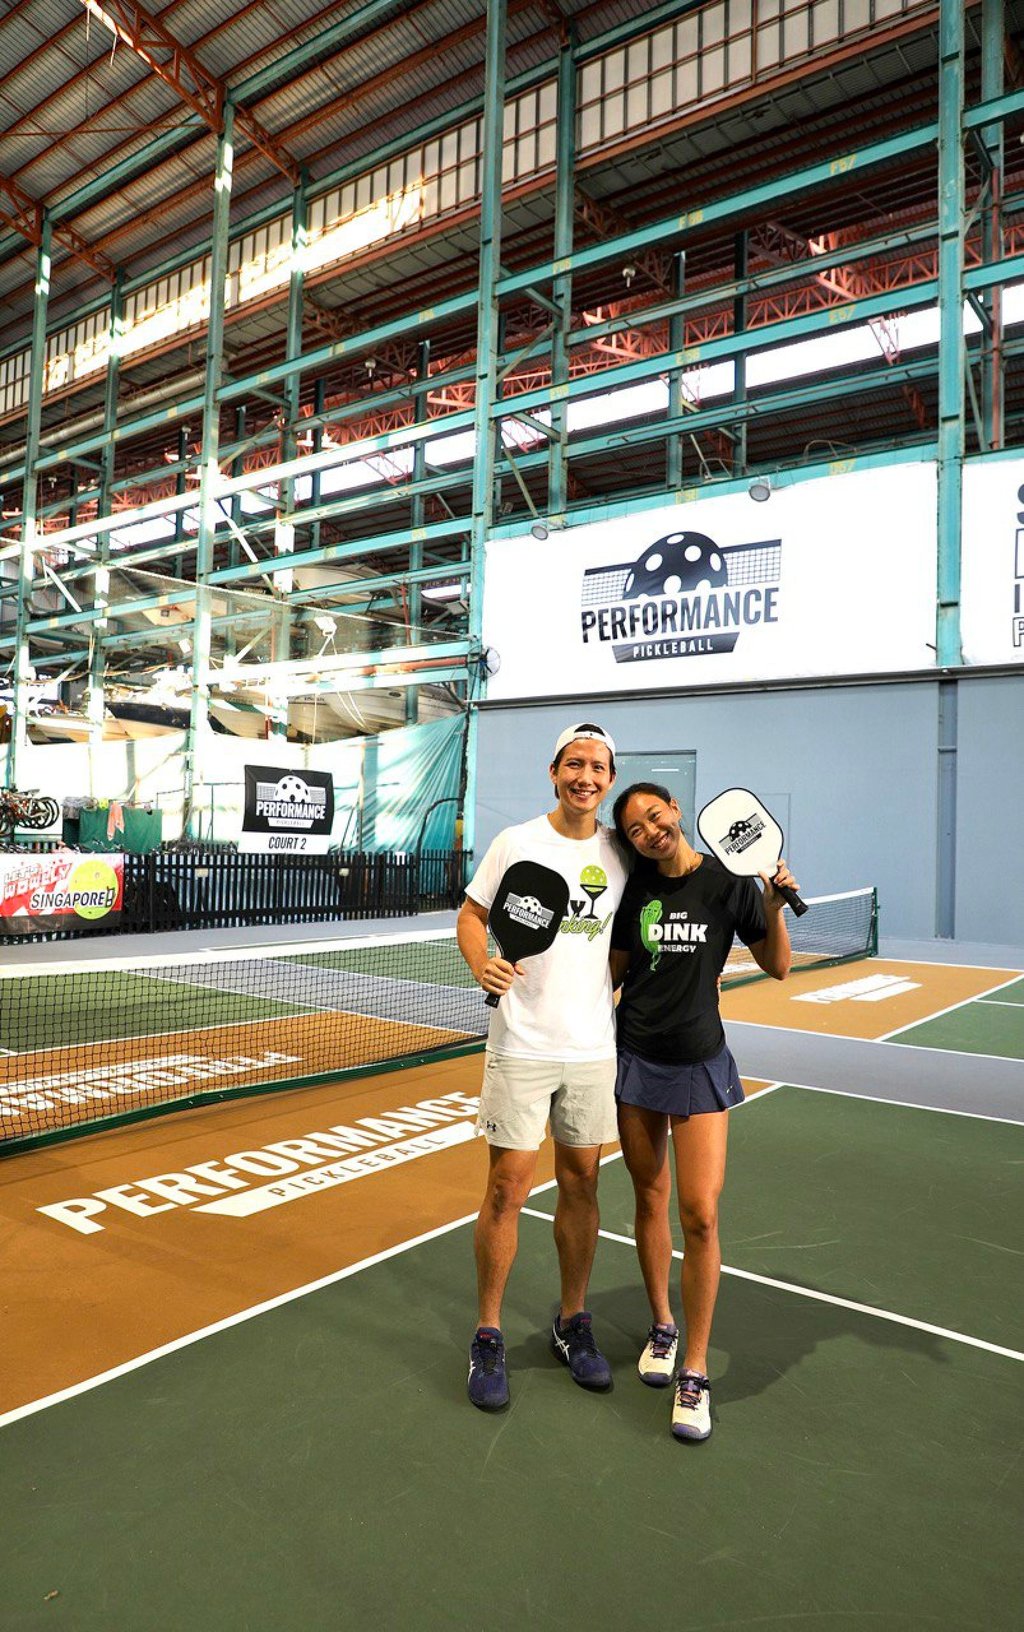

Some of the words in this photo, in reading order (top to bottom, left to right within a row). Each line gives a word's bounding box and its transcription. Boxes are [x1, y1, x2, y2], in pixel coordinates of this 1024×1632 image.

[581, 587, 780, 644] PERFORMANCE
[632, 638, 714, 659] PICKLEBALL
[256, 800, 326, 820] PERFORMANCE
[268, 836, 299, 850] COURT
[300, 837, 307, 850] 2
[724, 820, 767, 856] PERFORMANCE
[31, 891, 105, 909] SINGAPORE
[502, 902, 549, 929] PERFORMANCE
[559, 911, 613, 941] nking!
[669, 911, 688, 920] BIG
[648, 922, 709, 943] DINK
[657, 944, 697, 953] ENERGY
[35, 1091, 481, 1235] PERFORMANCE
[268, 1138, 447, 1198] PICKLEBALL
